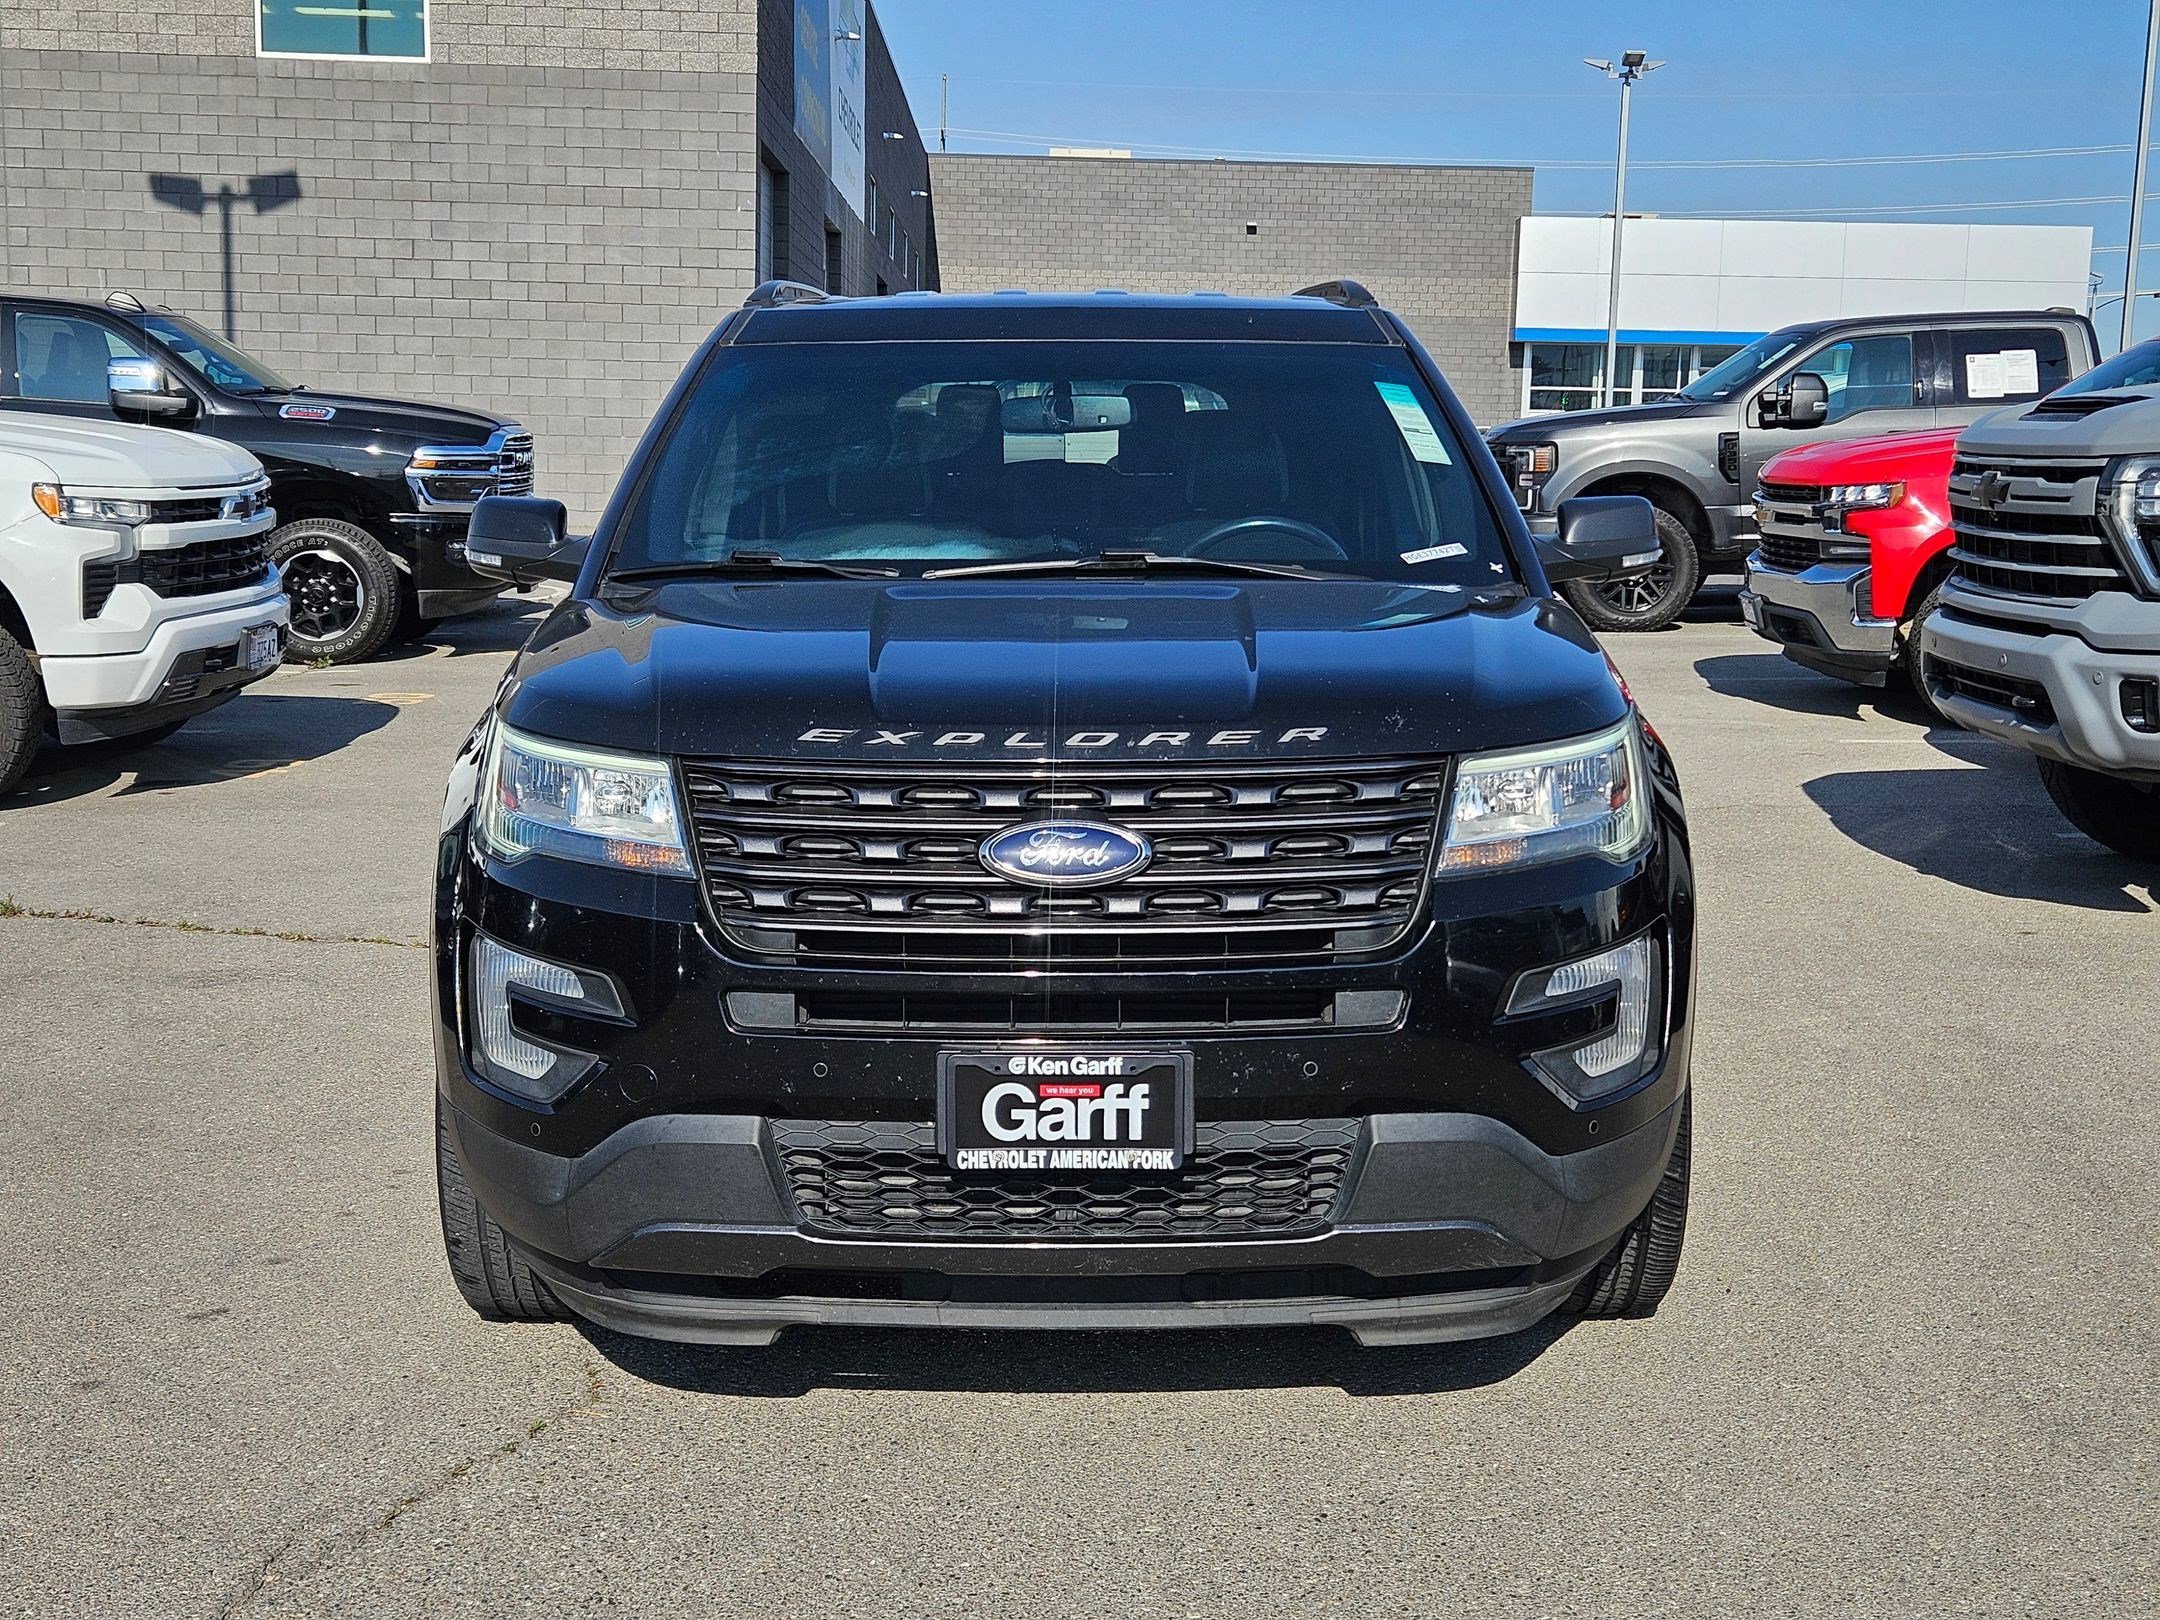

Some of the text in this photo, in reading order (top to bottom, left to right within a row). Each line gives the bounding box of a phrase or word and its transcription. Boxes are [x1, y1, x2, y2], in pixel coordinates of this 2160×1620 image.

[797, 726, 1328, 747] EXPLORER
[1018, 830, 1110, 868] Ford
[1027, 1056, 1123, 1075] Ken Garff
[1059, 1085, 1077, 1094] hear
[1078, 1087, 1094, 1096] you
[982, 1082, 1150, 1142] Garff
[957, 1151, 1174, 1170] CHEVROLET AMERICAN FORK
